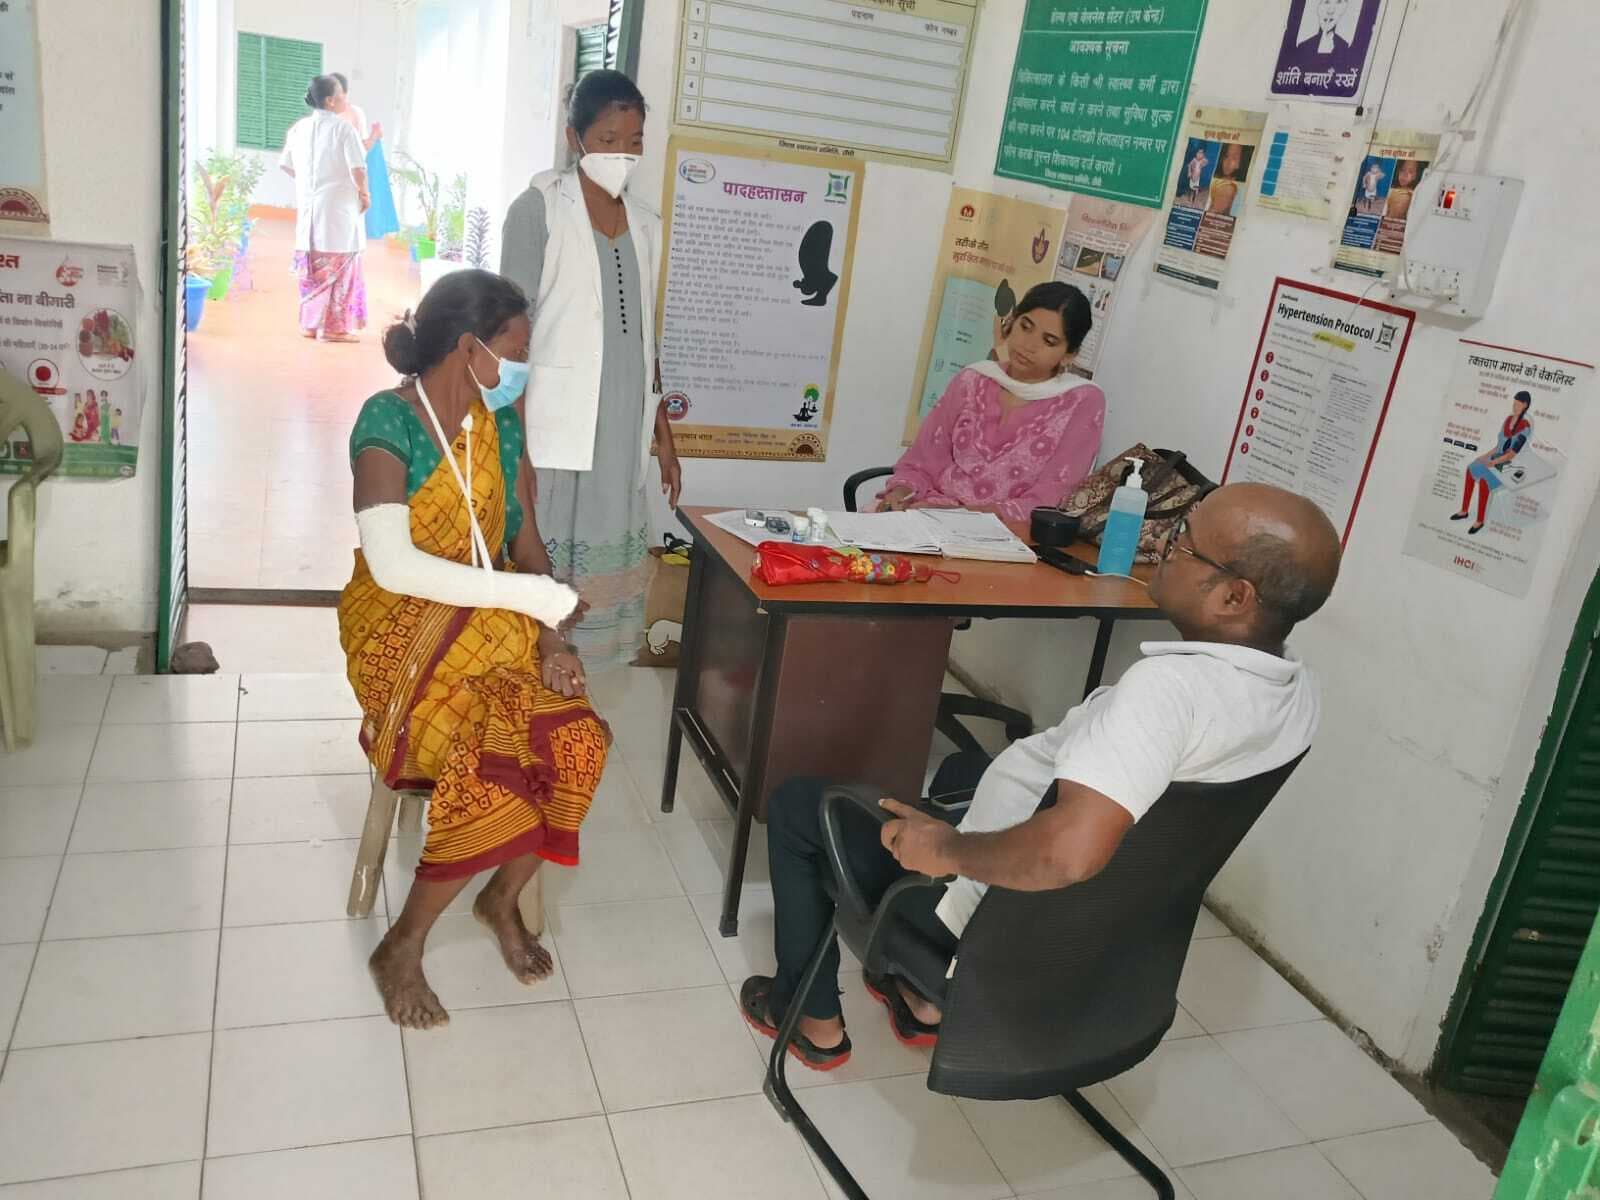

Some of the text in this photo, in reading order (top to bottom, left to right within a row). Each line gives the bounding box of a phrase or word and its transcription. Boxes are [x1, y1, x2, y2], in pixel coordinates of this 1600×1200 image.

[1105, 40, 1131, 61] सूचना
[1092, 73, 1104, 89] भी
[1160, 79, 1182, 95] द्वारा
[1275, 66, 1301, 86] शांति
[1335, 67, 1359, 87] रखें
[1078, 103, 1085, 115] न
[1106, 105, 1122, 119] तथा
[1151, 108, 1175, 128] शुल्क
[1057, 127, 1071, 141] 104
[1155, 138, 1168, 153] पर
[723, 181, 808, 204] पादहस्तासन
[1277, 302, 1375, 341] Hypertension Protocol
[1468, 355, 1498, 370] रक्तचाप
[1499, 361, 1524, 376] मापने
[1524, 364, 1538, 378] की
[1538, 367, 1577, 387] चेकलिस्ट
[1454, 555, 1474, 570] IHCI
